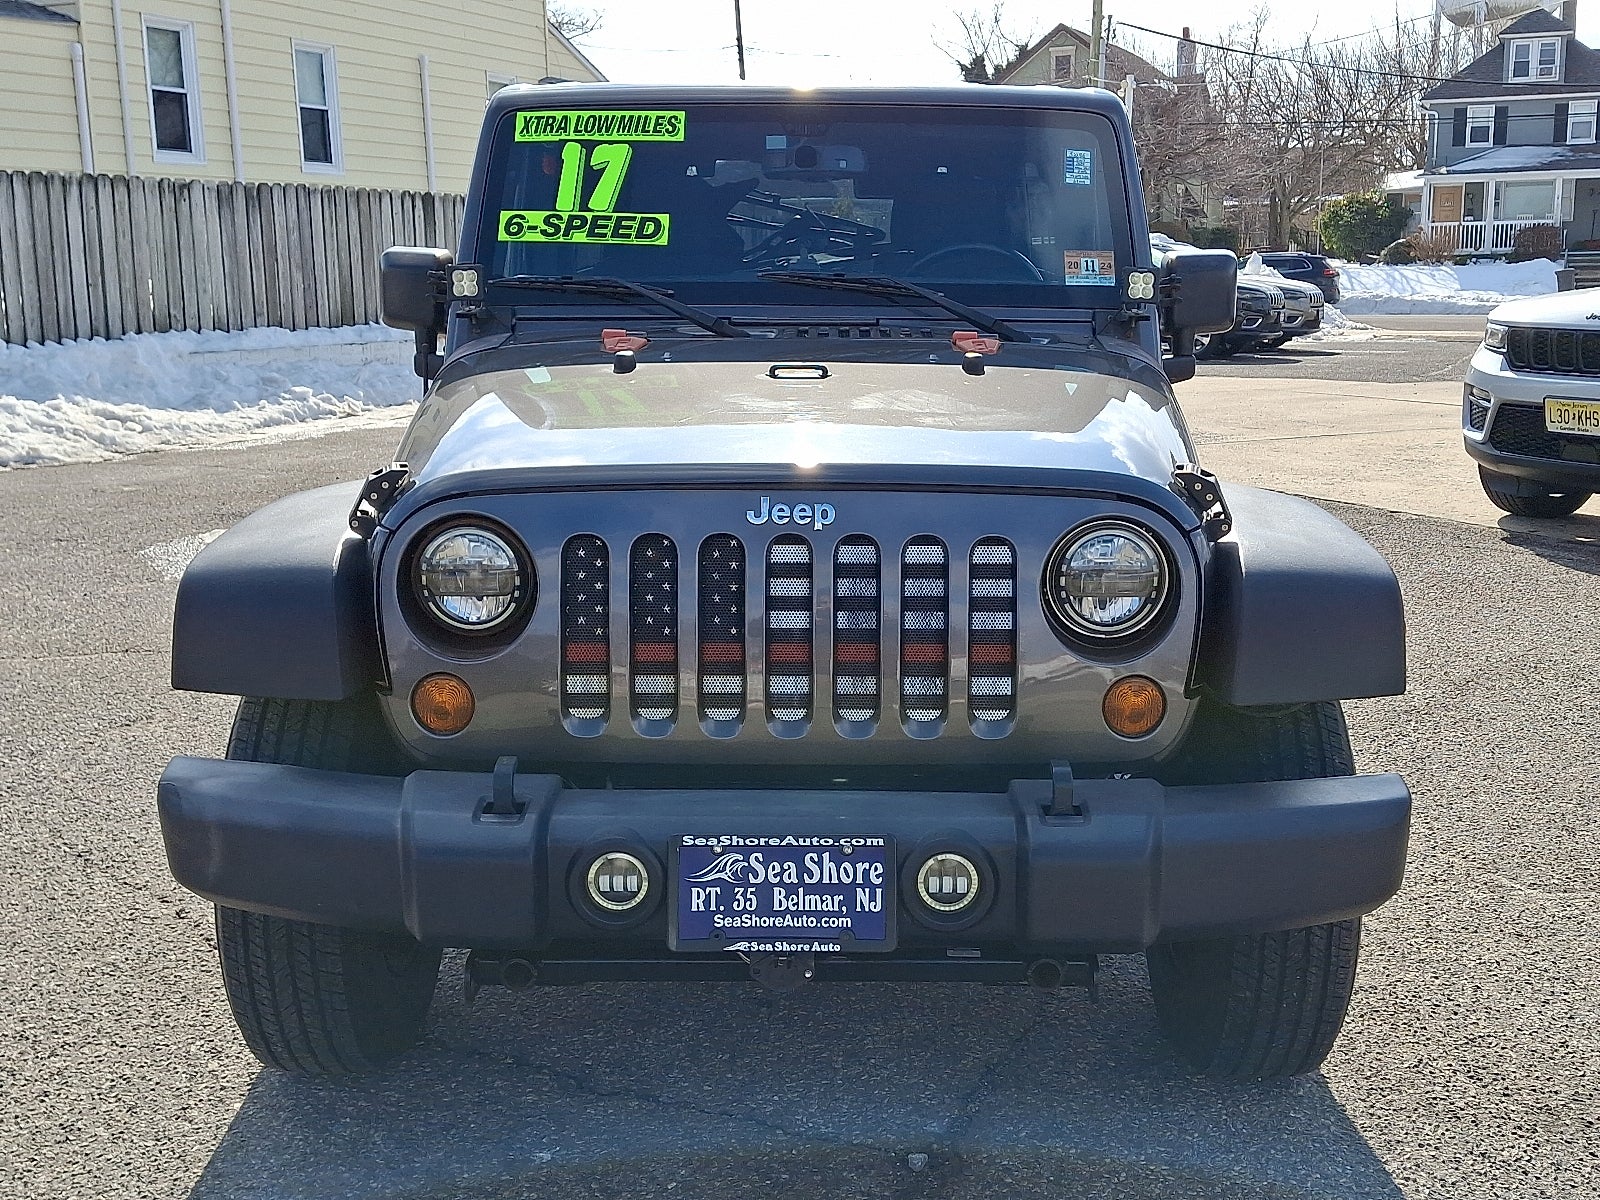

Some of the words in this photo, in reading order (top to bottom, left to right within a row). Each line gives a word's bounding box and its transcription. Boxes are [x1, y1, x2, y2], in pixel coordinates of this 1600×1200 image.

[519, 114, 570, 136] XTRA
[555, 141, 632, 212] 17
[503, 213, 664, 242] 6-SPEED
[1067, 260, 1079, 270] 20
[1083, 259, 1097, 273] 11
[746, 496, 836, 531] Jeep
[682, 835, 885, 846] SeaShoreAuto.com
[749, 852, 799, 884] Sea
[803, 851, 884, 885] Shore
[690, 887, 725, 912] RT.
[732, 887, 758, 912] 35
[773, 887, 848, 915] Belmar,
[855, 887, 883, 912] NJ
[713, 913, 852, 928] SeaShoreAuto.com
[750, 942, 773, 952] Sea
[774, 941, 809, 952] Shore
[811, 941, 841, 952] Auto
